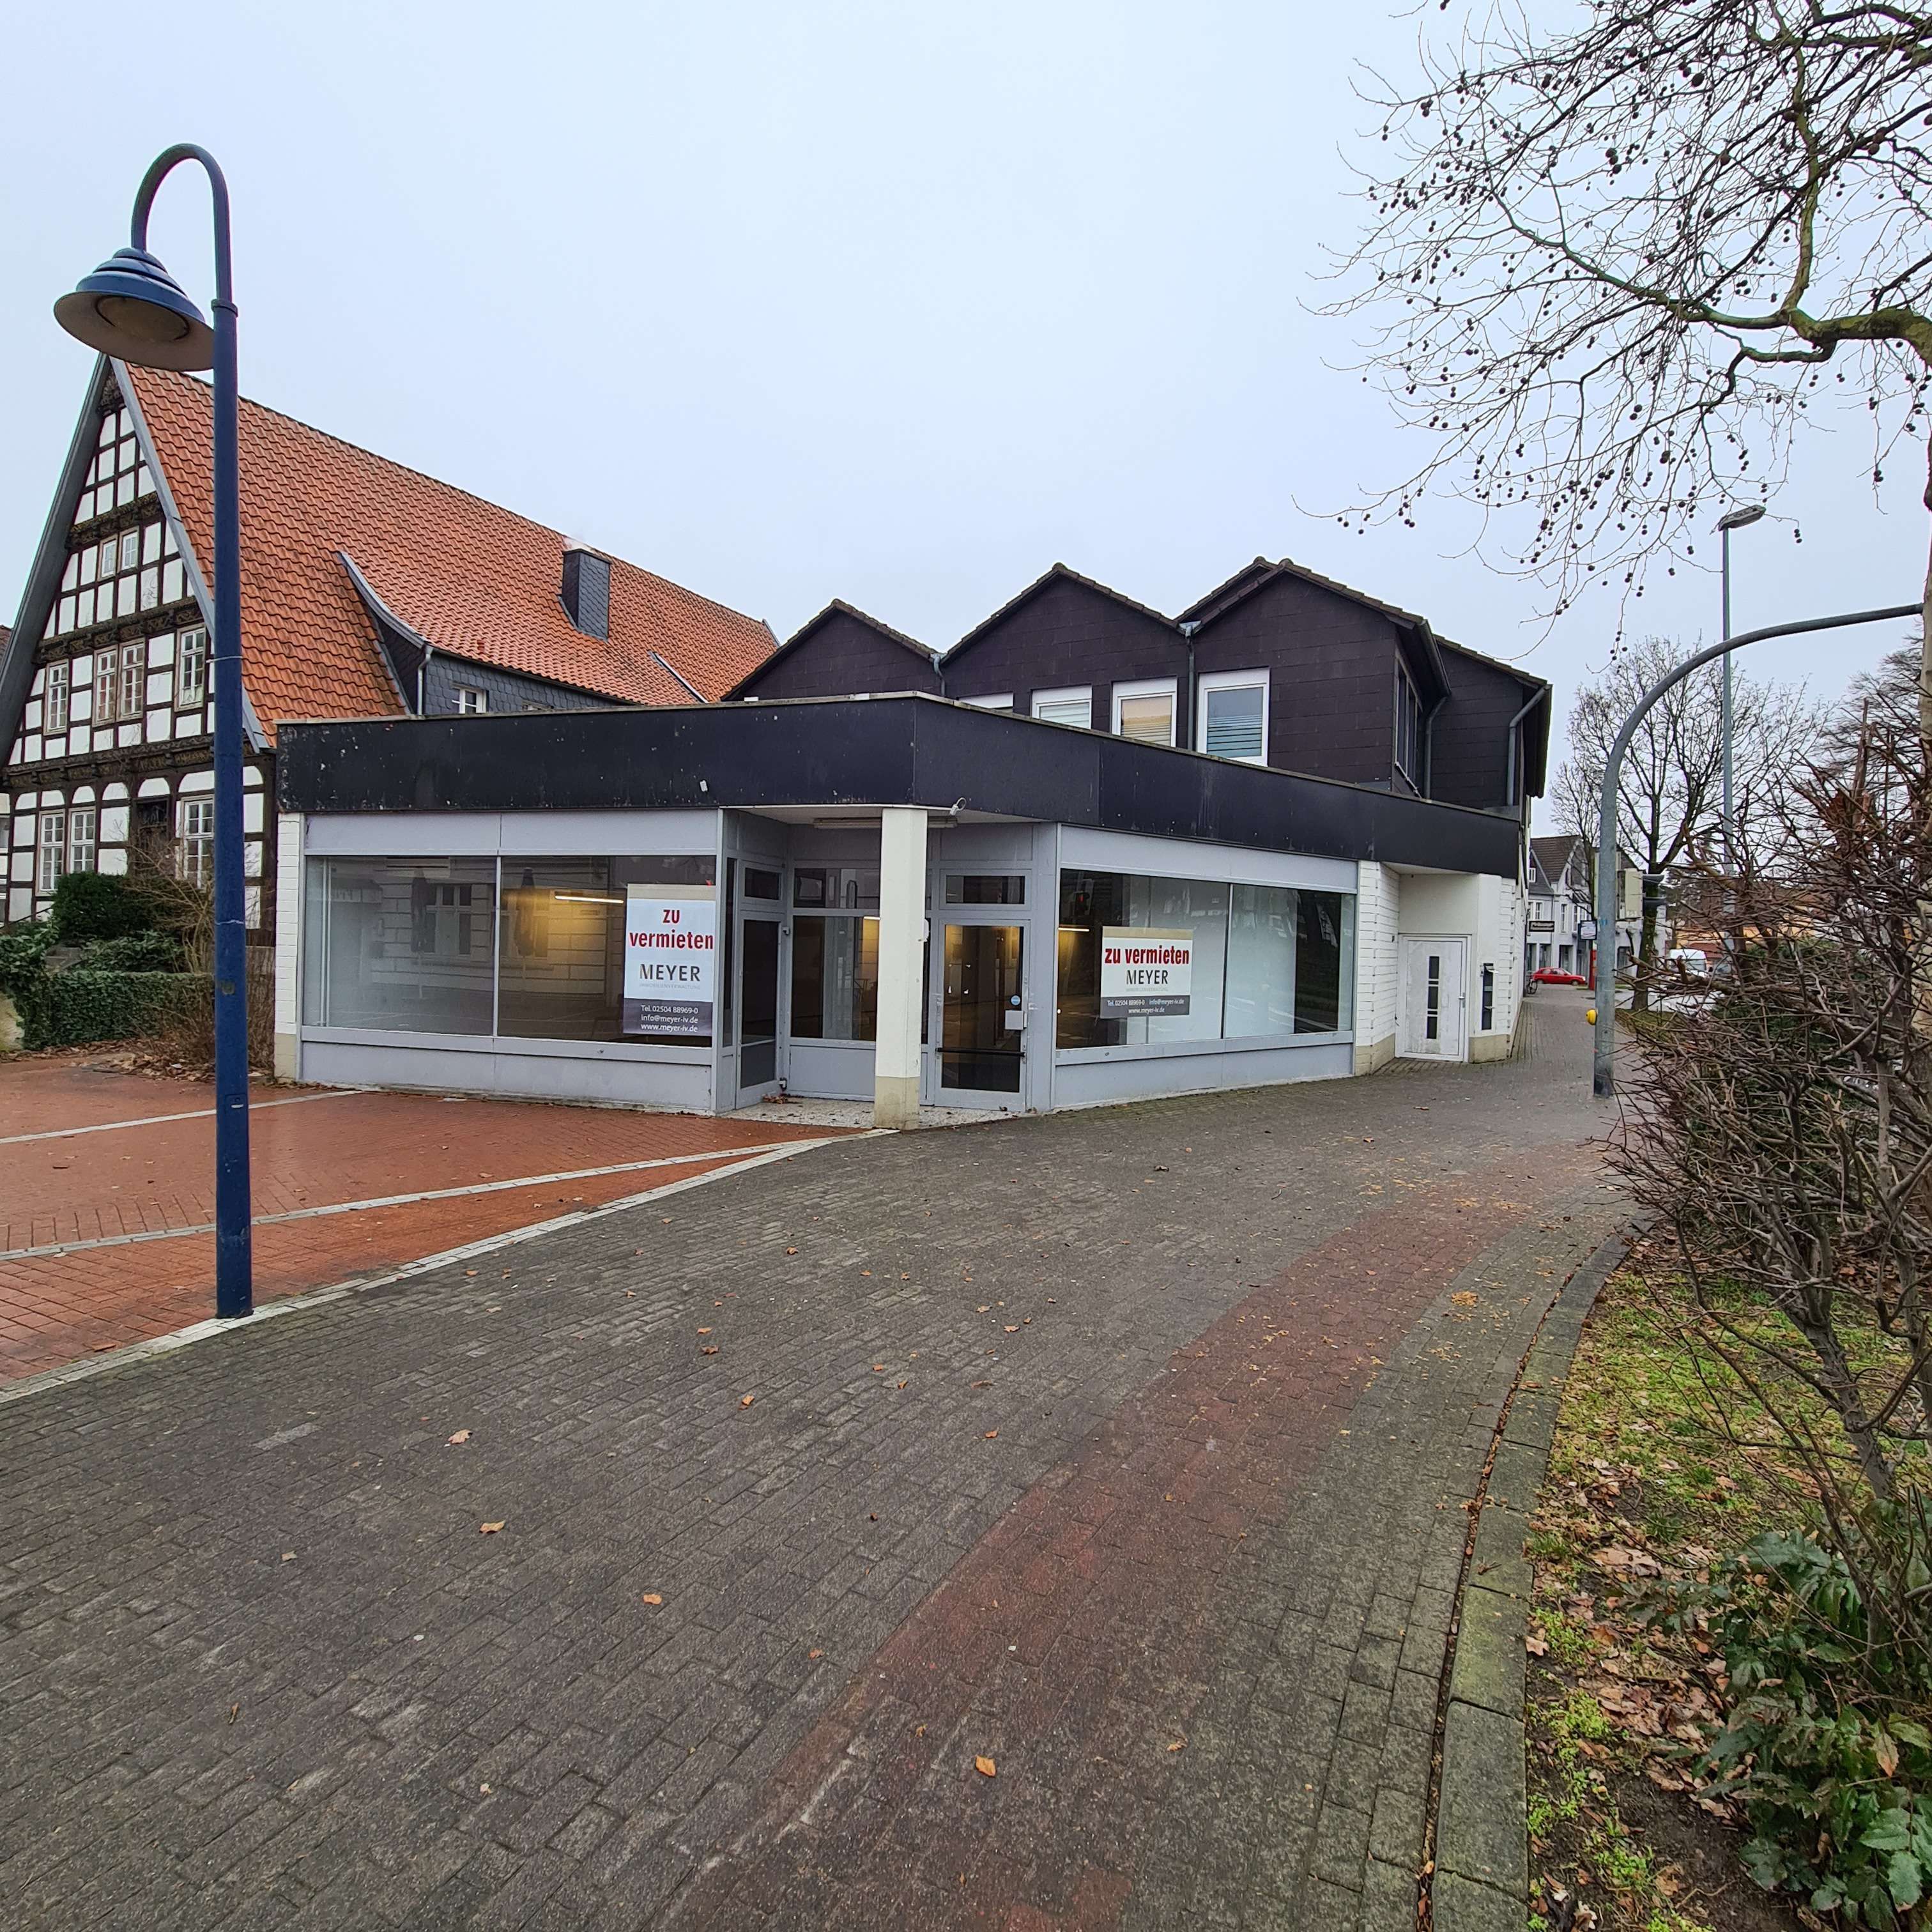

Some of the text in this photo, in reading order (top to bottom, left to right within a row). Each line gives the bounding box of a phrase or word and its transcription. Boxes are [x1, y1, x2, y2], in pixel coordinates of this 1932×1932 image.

[629, 929, 714, 949] vermieten
[1105, 945, 1190, 965] zu vermieten
[640, 963, 701, 982] MEYER
[1126, 970, 1169, 985] MEYER
[641, 1014, 698, 1024] info@meyer-iv.de
[641, 1023, 698, 1032] www.meyer-iv.de
